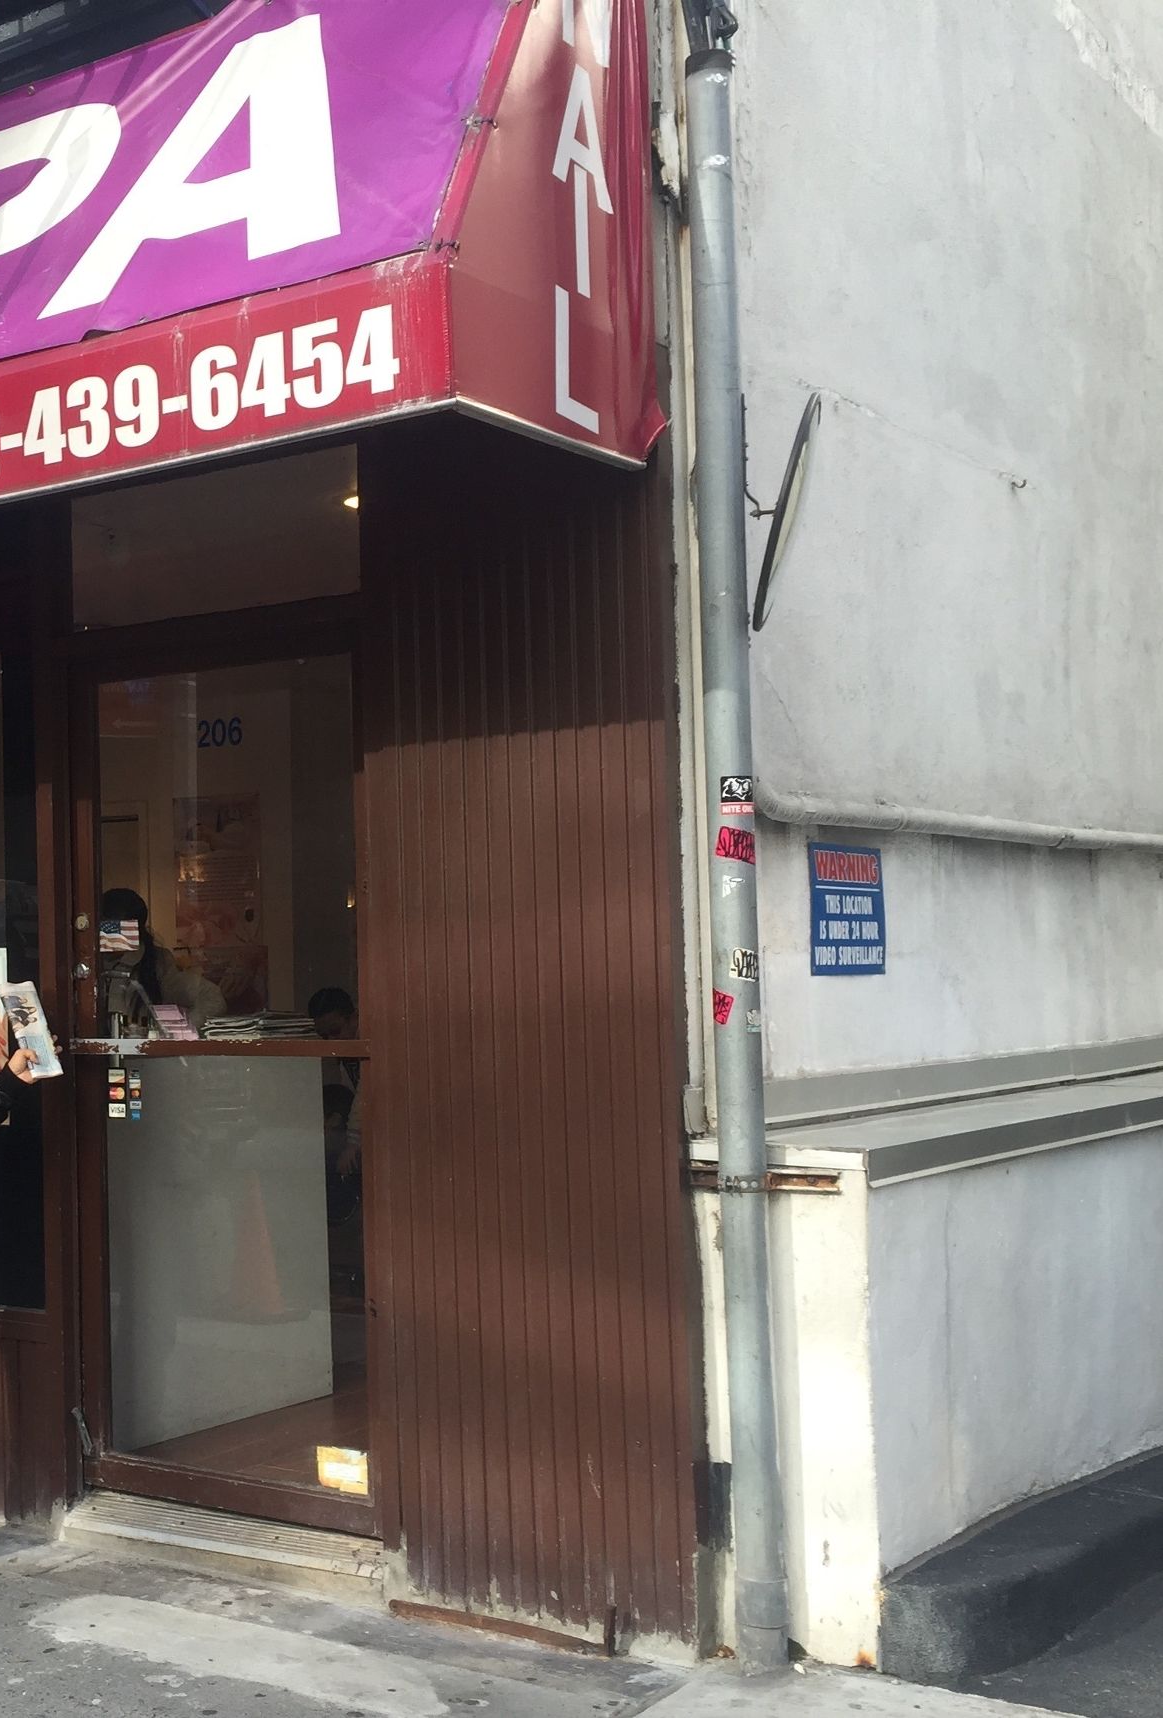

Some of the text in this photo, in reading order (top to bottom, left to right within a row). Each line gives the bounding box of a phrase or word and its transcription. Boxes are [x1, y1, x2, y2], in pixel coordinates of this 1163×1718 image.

[197, 717, 243, 748] 206
[814, 850, 879, 885] WARNING
[825, 894, 873, 915] THIS LOCATION
[819, 920, 879, 940] IS UNDER 24 HOUR
[814, 946, 883, 966] VIDEO SURVEILLANCE
